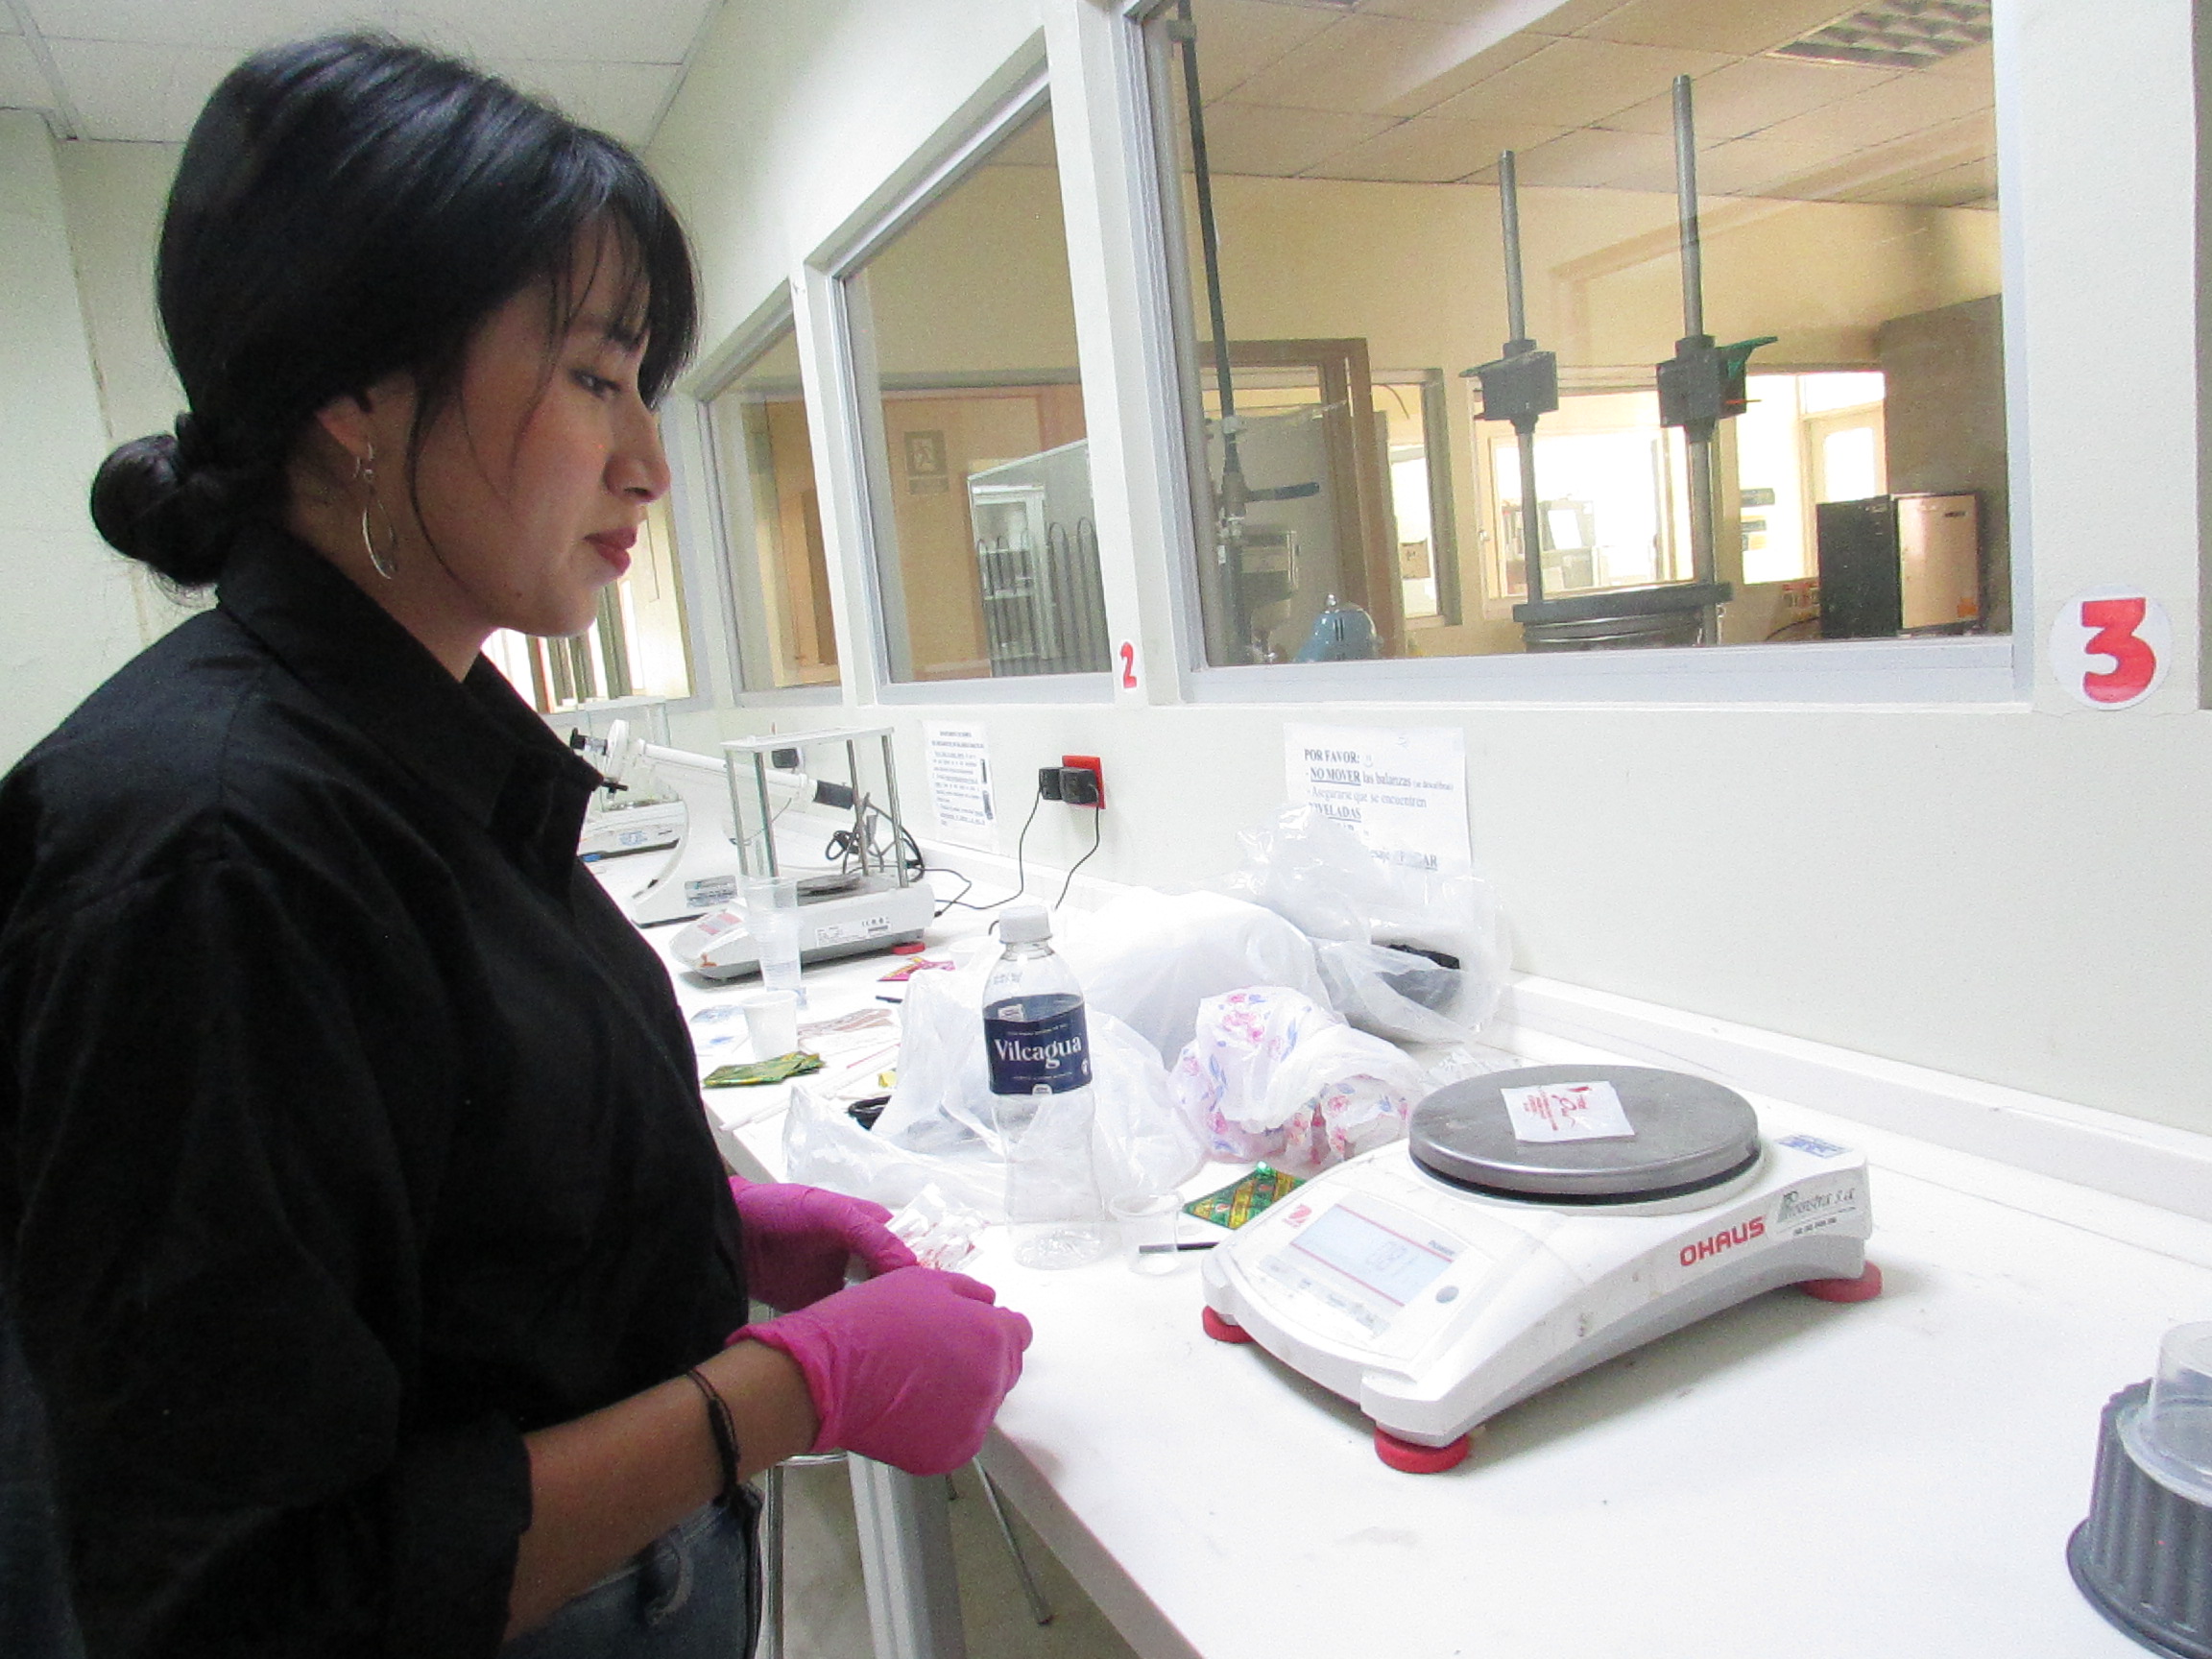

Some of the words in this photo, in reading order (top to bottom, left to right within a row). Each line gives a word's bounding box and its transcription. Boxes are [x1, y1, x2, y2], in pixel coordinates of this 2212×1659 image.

[1120, 641, 1137, 688] 2
[2081, 597, 2156, 703] 3
[1305, 749, 1323, 761] POR
[1325, 750, 1359, 764] FAVOR:
[1310, 767, 1325, 780] NO
[1327, 768, 1360, 783] MOVER
[1375, 772, 1411, 787] balanzas
[994, 1036, 1082, 1069] Vilcagua
[1680, 1215, 1766, 1266] OHAUS
